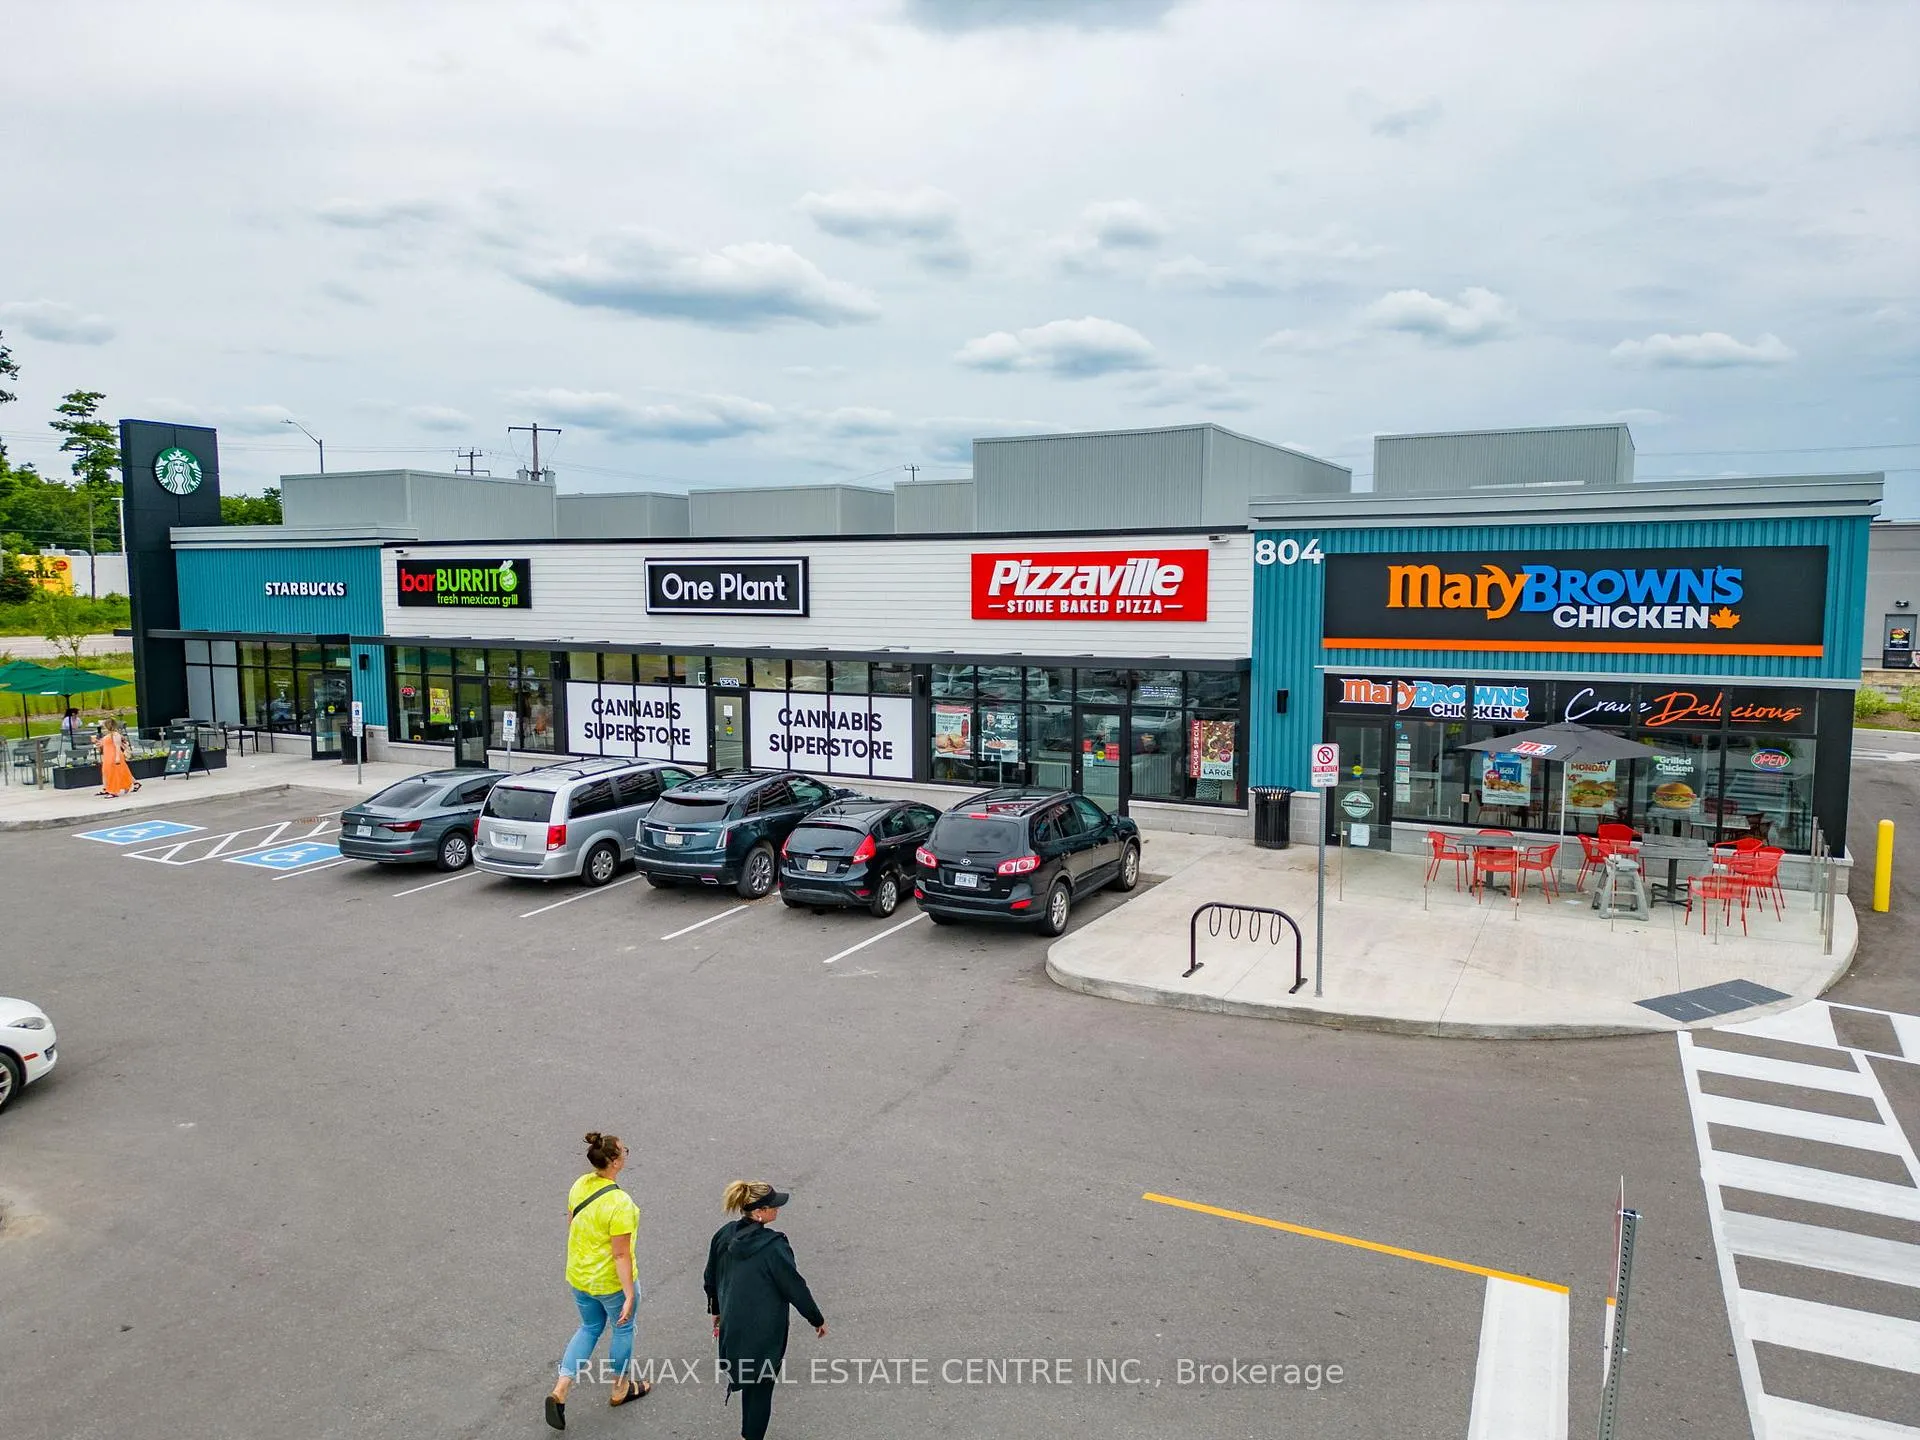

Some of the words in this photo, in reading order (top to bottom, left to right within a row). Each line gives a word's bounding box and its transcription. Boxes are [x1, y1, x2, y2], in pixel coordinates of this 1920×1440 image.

[1255, 538, 1325, 565] 804
[988, 558, 1184, 596] Pizzaville
[265, 582, 345, 596] STARBUCKS
[661, 573, 714, 600] One
[720, 573, 788, 601] Plant
[437, 593, 459, 604] fresh
[461, 594, 500, 605] mexican
[502, 594, 518, 607] grill
[1007, 600, 1054, 613] STONE
[1060, 600, 1109, 613] BAKED
[1116, 600, 1162, 613] PIZZA
[1552, 606, 1709, 629] CHICKEN
[591, 698, 681, 720] CANNABIS
[1431, 704, 1512, 719] CHICKEN
[778, 708, 882, 732] CANNABIS
[584, 722, 691, 746] SUPERSTORE
[769, 733, 893, 760] SUPERSTORE
[1659, 756, 1692, 765] Grilled
[1752, 753, 1788, 766] OPEN
[1203, 769, 1232, 777] LARGE
[1571, 763, 1609, 772] MONDAY
[1656, 763, 1694, 773] Chicken
